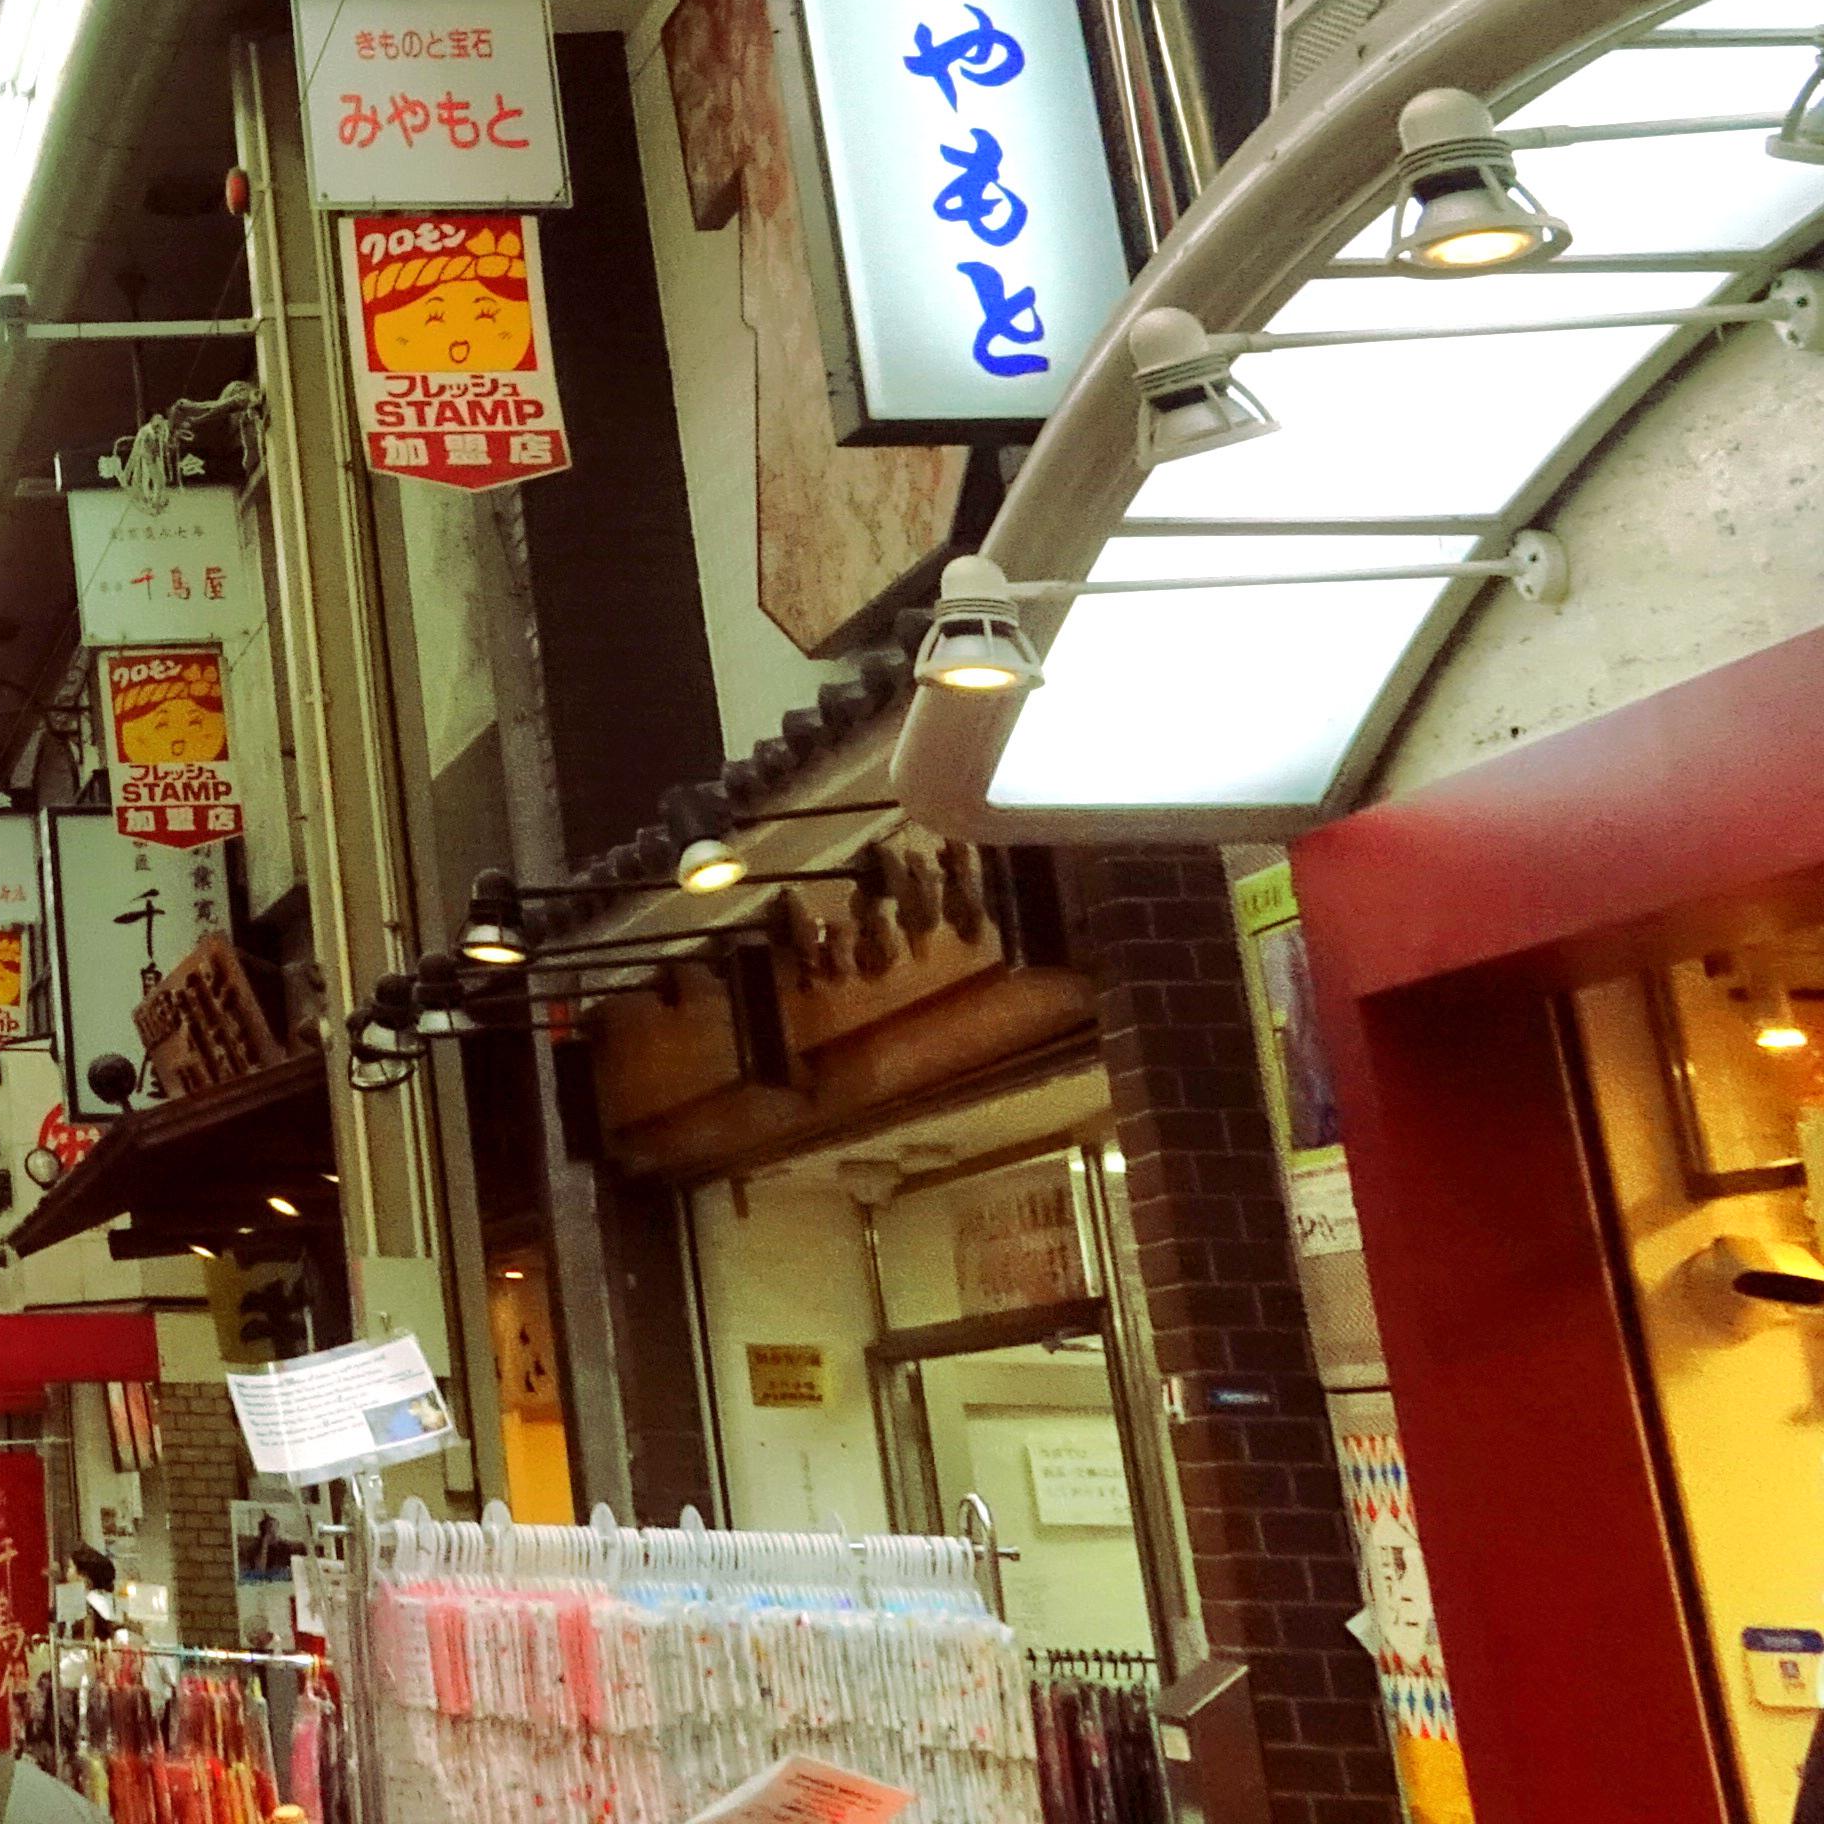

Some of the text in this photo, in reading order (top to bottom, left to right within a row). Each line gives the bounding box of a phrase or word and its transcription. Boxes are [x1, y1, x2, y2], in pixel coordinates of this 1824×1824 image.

[354, 27, 495, 62] きものと宝石
[337, 90, 531, 151] みやもと
[360, 221, 467, 266] クロモン
[385, 374, 523, 398] フレッシュ
[374, 399, 546, 429] STAMP
[381, 434, 553, 467] 加盟店
[129, 565, 228, 601] 千鳥屋
[112, 659, 183, 688] クロモン
[129, 764, 219, 782] フレッシュ
[122, 780, 233, 803] STAMP
